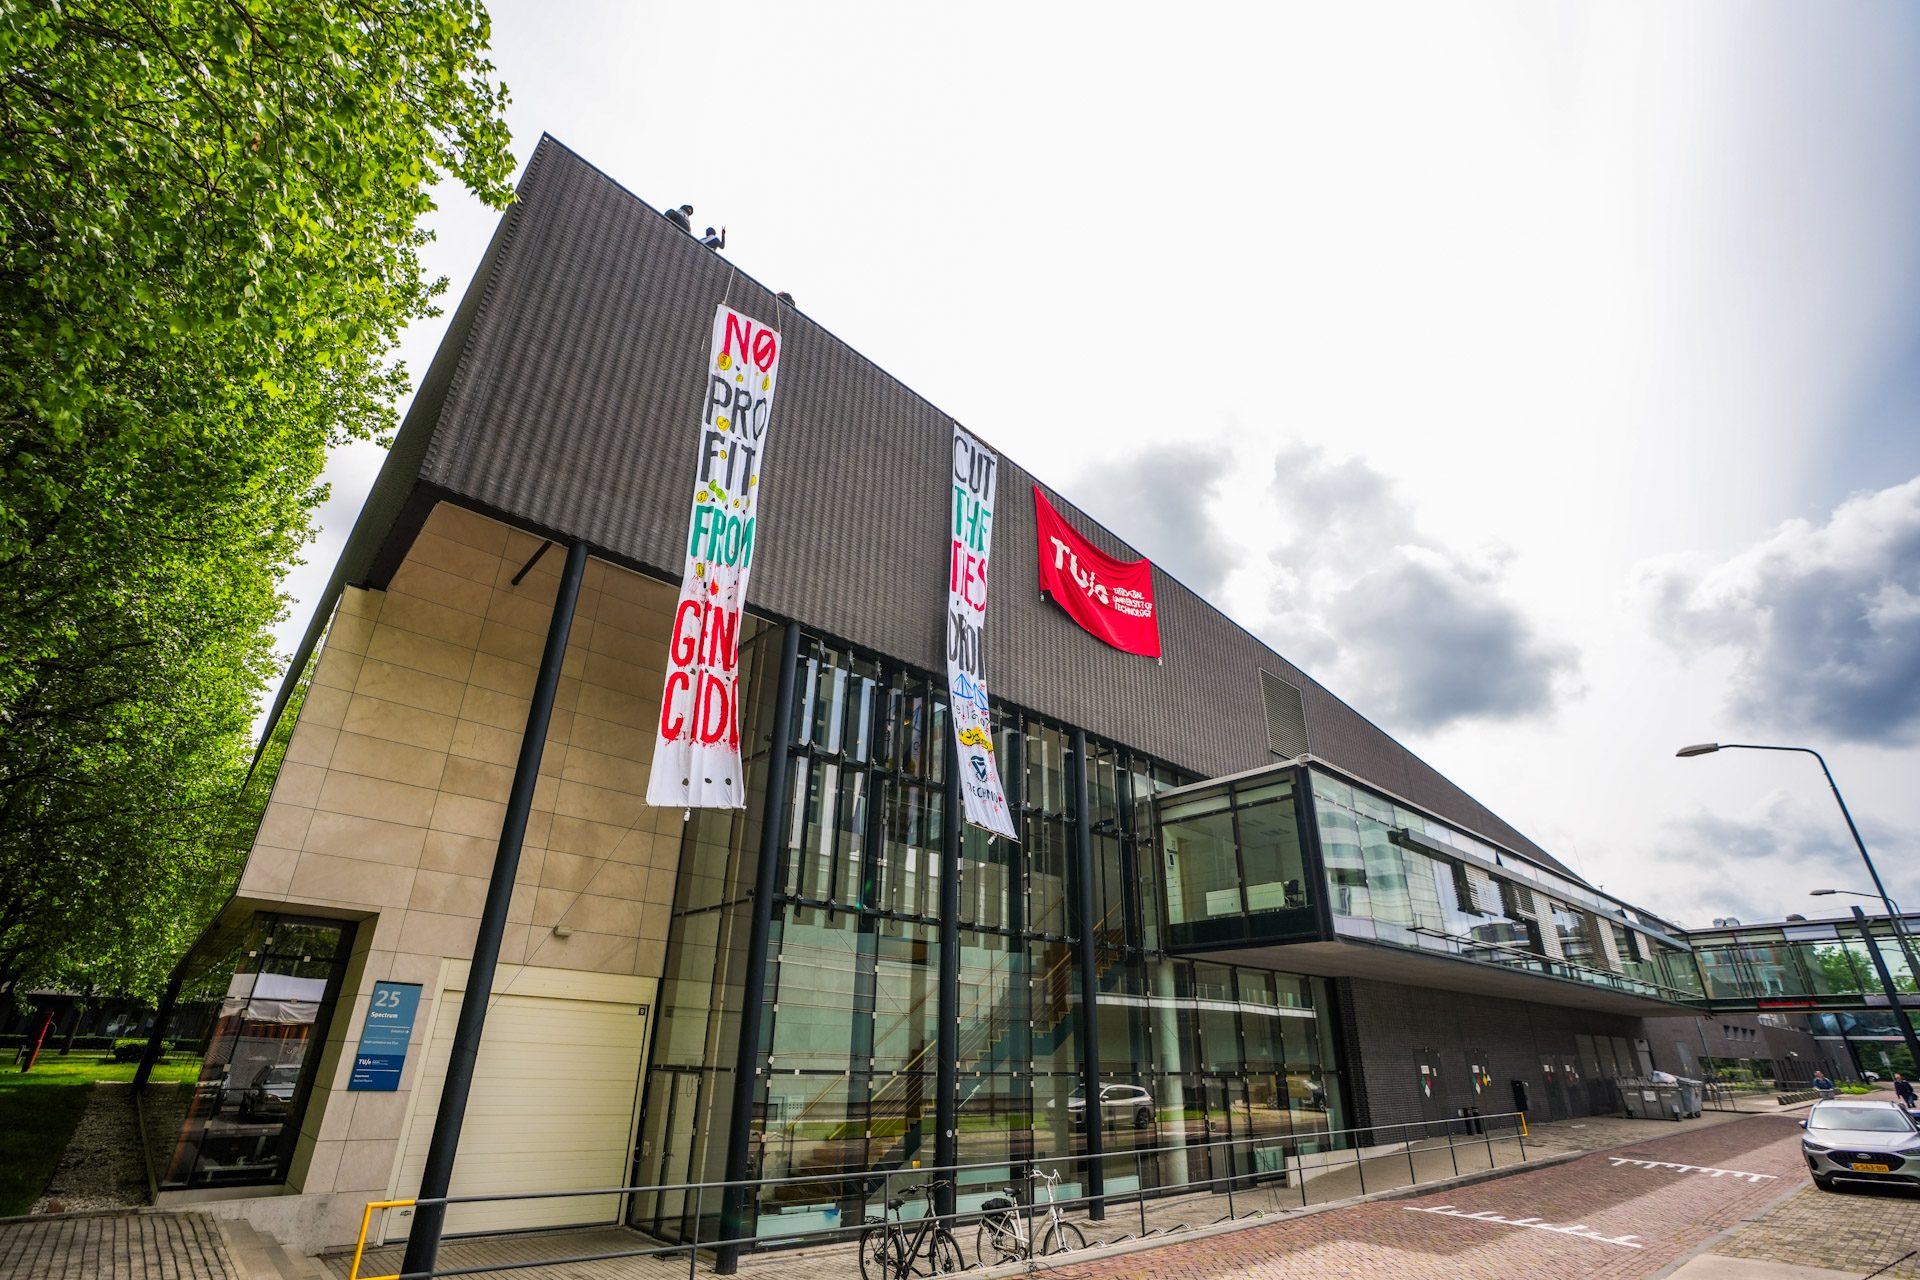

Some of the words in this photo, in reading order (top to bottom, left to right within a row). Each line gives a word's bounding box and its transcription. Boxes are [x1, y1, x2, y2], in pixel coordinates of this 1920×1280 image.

[705, 374, 767, 440] PRO
[700, 430, 756, 496] FIT
[954, 436, 995, 501] CUT
[954, 486, 991, 551] THE
[952, 540, 986, 612] TIES
[371, 1011, 399, 1019] Spectrum
[375, 990, 401, 1007] 25
